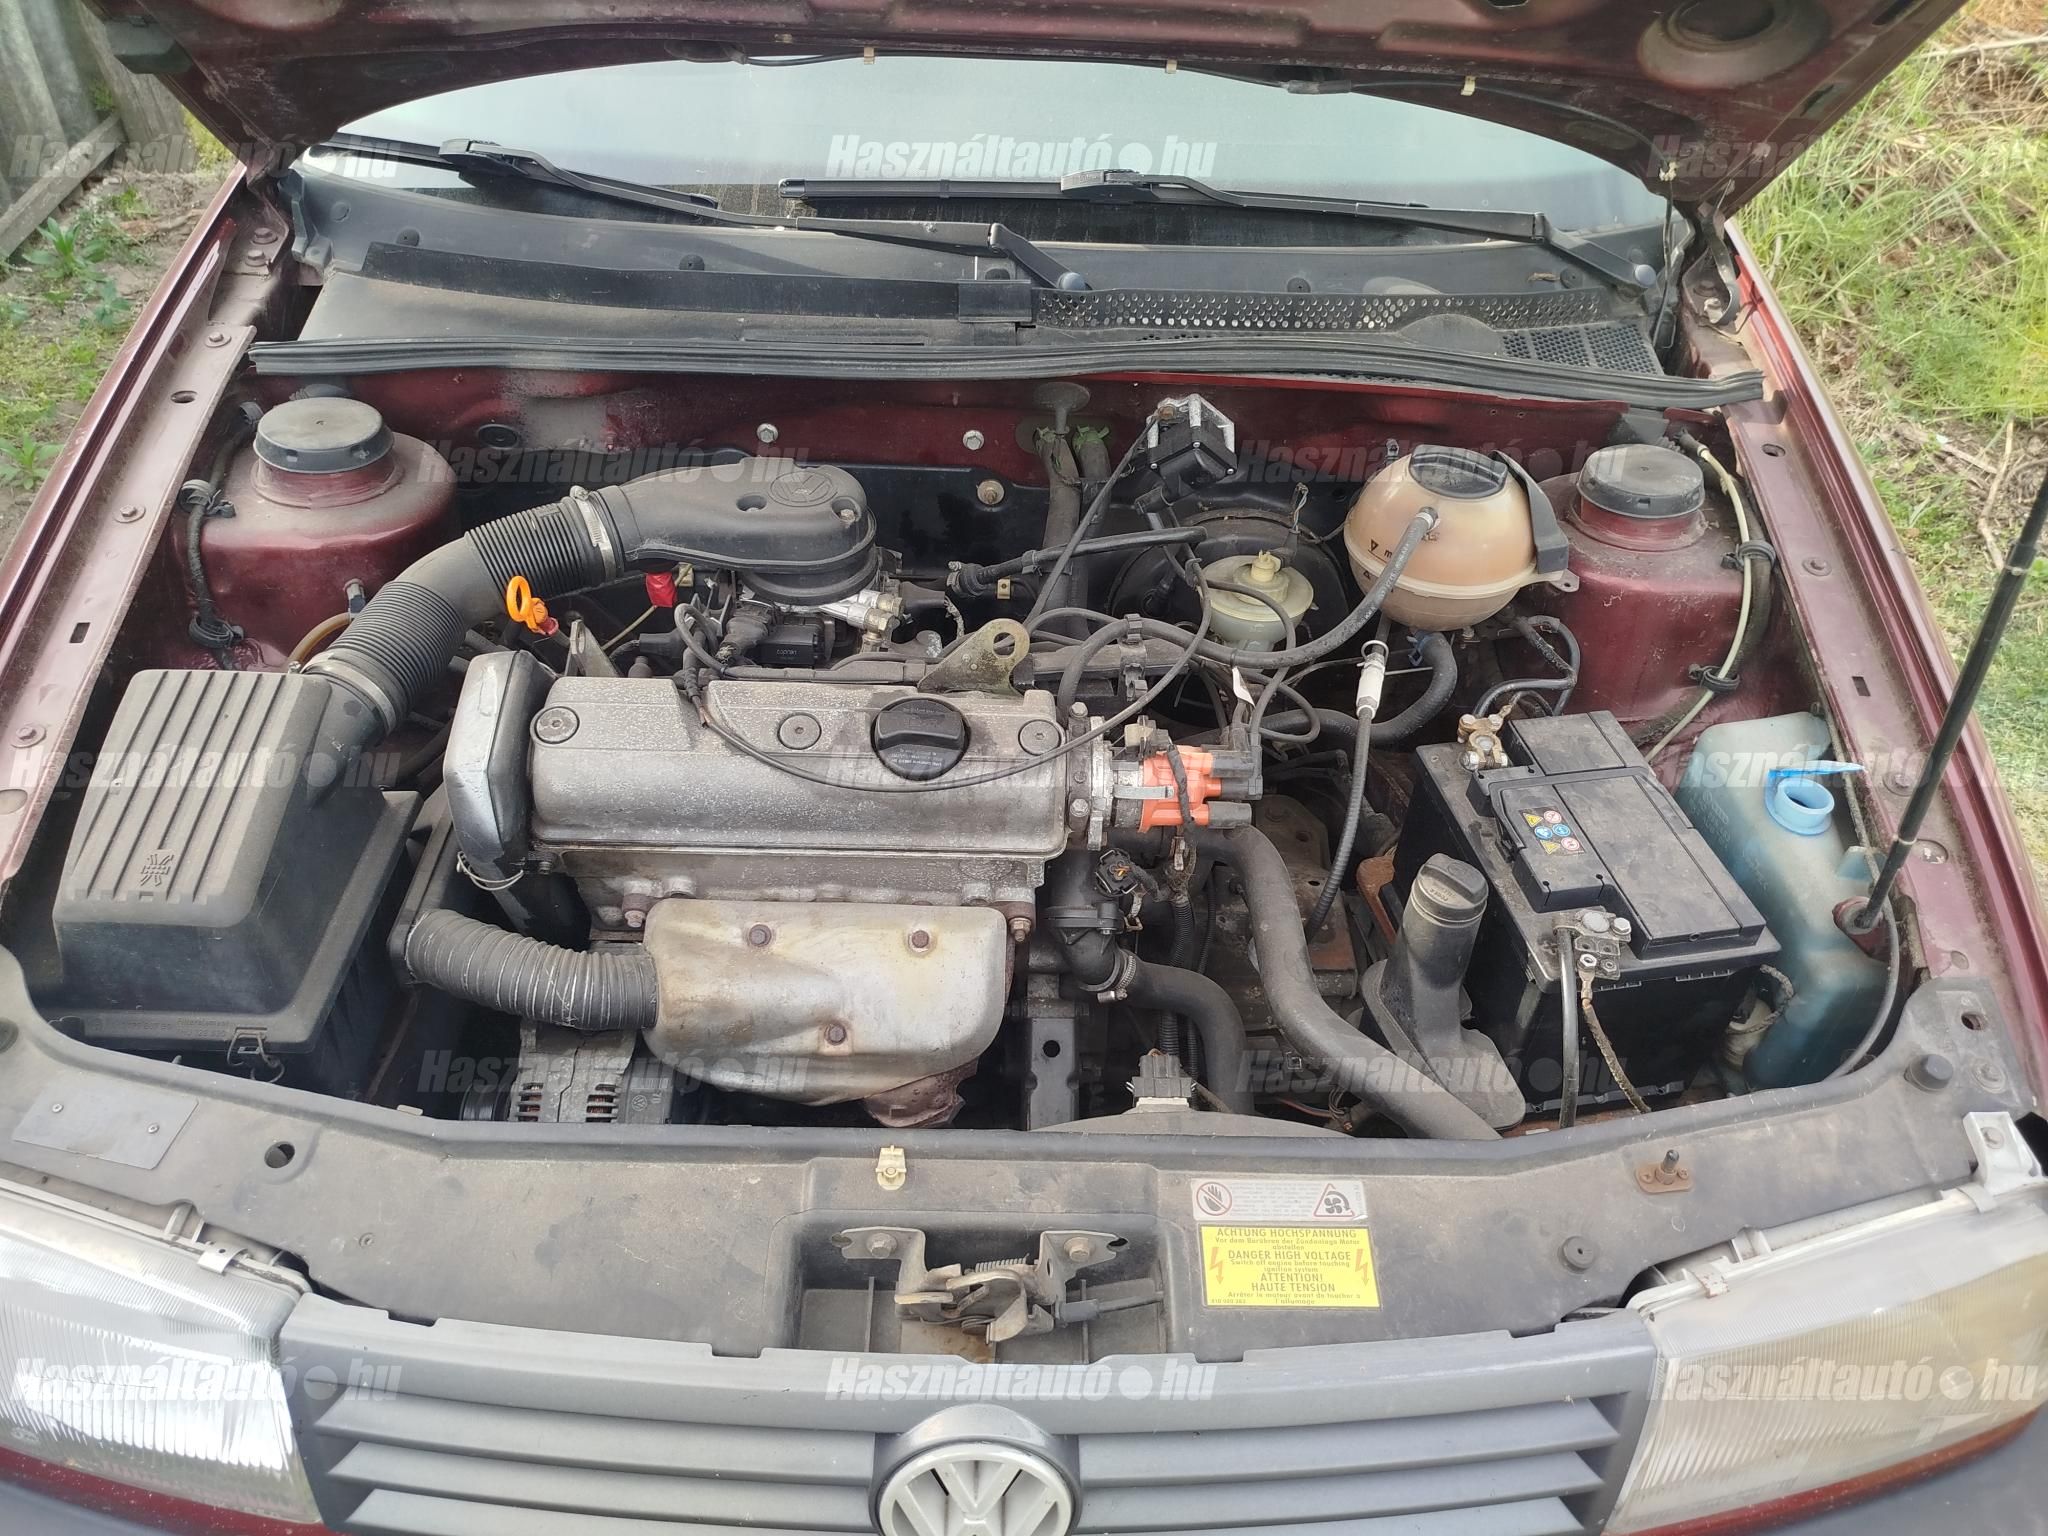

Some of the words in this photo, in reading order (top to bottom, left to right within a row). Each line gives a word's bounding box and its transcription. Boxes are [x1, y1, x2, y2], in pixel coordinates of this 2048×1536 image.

[1217, 1228, 1266, 1237] ACHTUNG
[1270, 1229, 1357, 1238] HOCHSPANNUNG
[1228, 1250, 1271, 1259] DANGER
[1275, 1251, 1301, 1260] HIGH
[1304, 1251, 1351, 1261] VOLTAGE
[1261, 1273, 1323, 1282] ATTENTION!
[1251, 1282, 1287, 1292] HAUTE
[1289, 1283, 1336, 1292] TENSION
